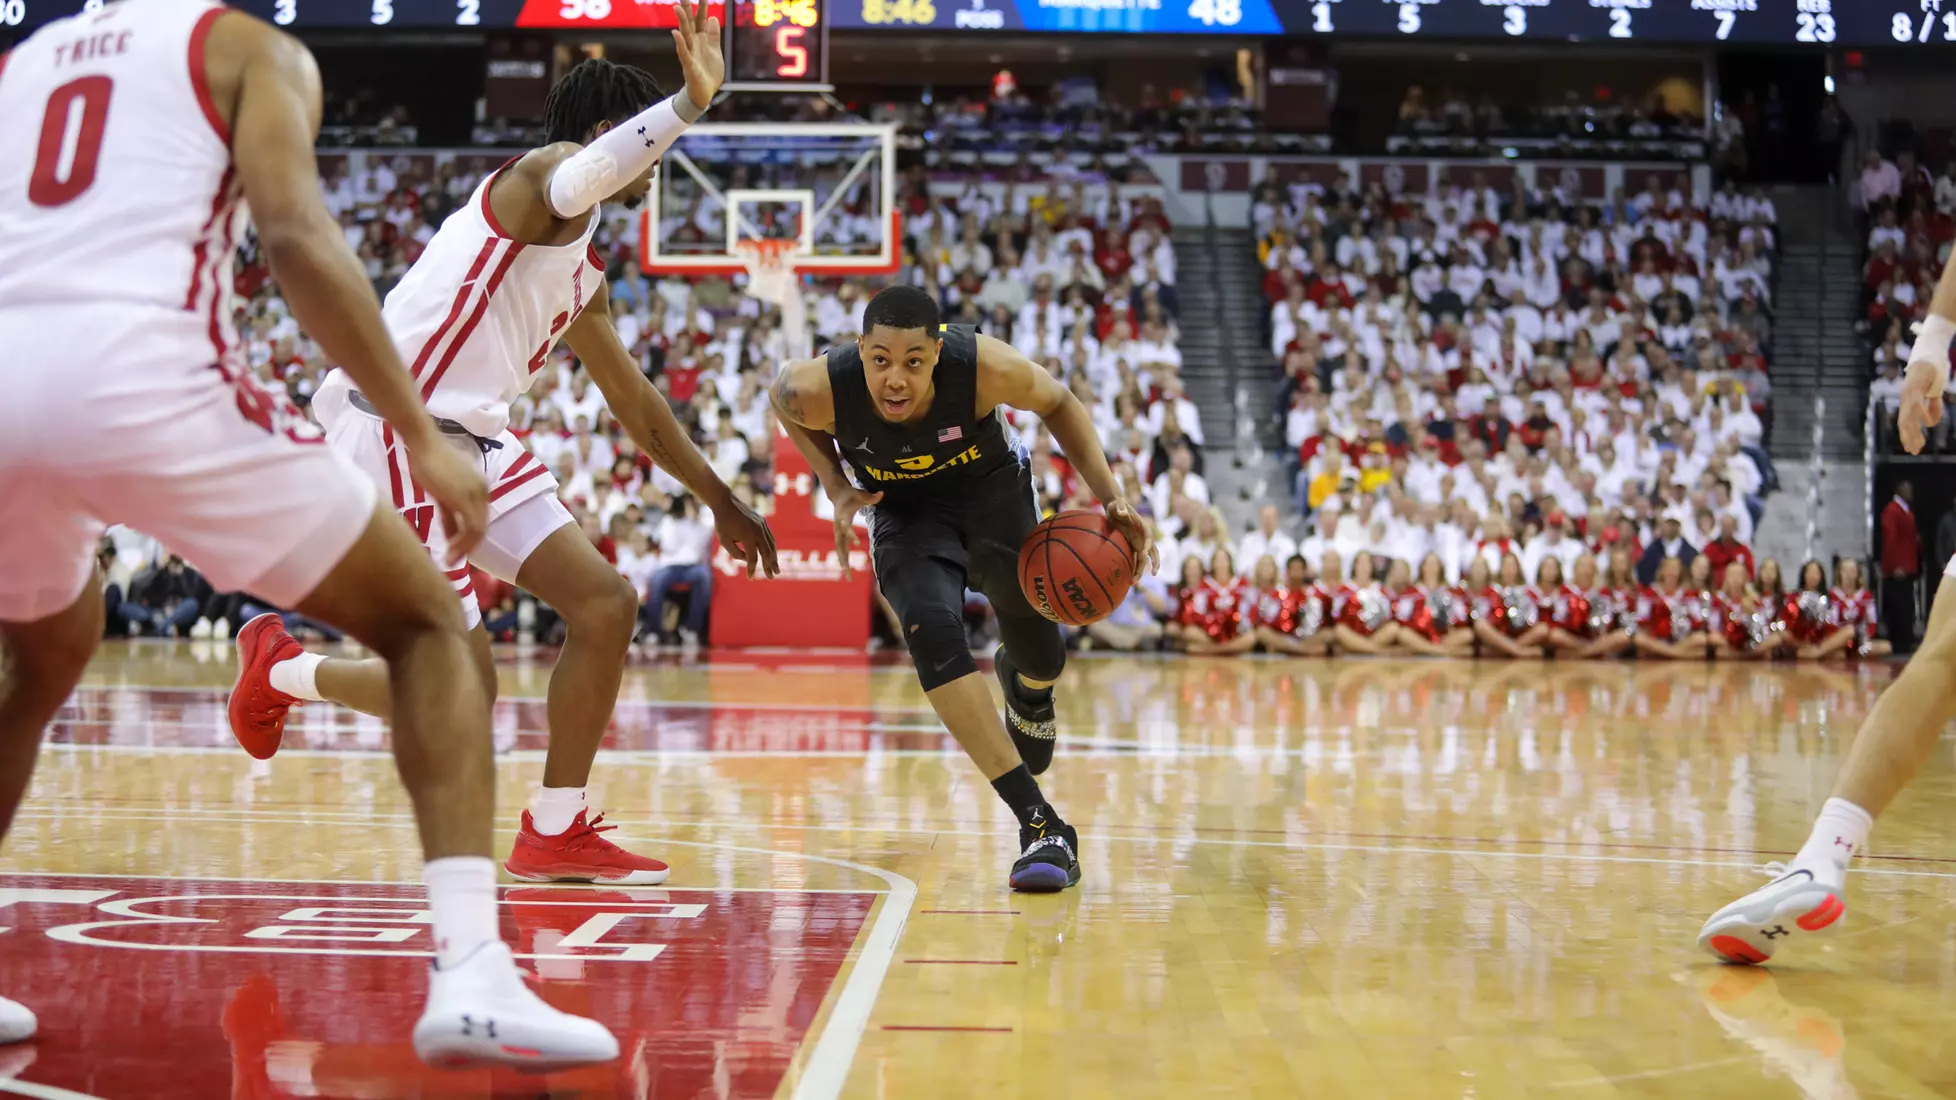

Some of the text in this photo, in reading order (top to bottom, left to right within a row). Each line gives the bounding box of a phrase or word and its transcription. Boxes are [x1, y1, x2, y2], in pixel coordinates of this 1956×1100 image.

[1311, 2, 1334, 32] 1
[1397, 3, 1421, 34] 5
[1502, 5, 1527, 36] 3
[1608, 8, 1633, 38] 2
[1713, 9, 1736, 40] 7
[1795, 12, 1836, 43] 23
[776, 27, 808, 77] 5
[28, 74, 113, 208] 0
[865, 444, 982, 481] MARQETTE
[1061, 576, 1101, 619] NCAA
